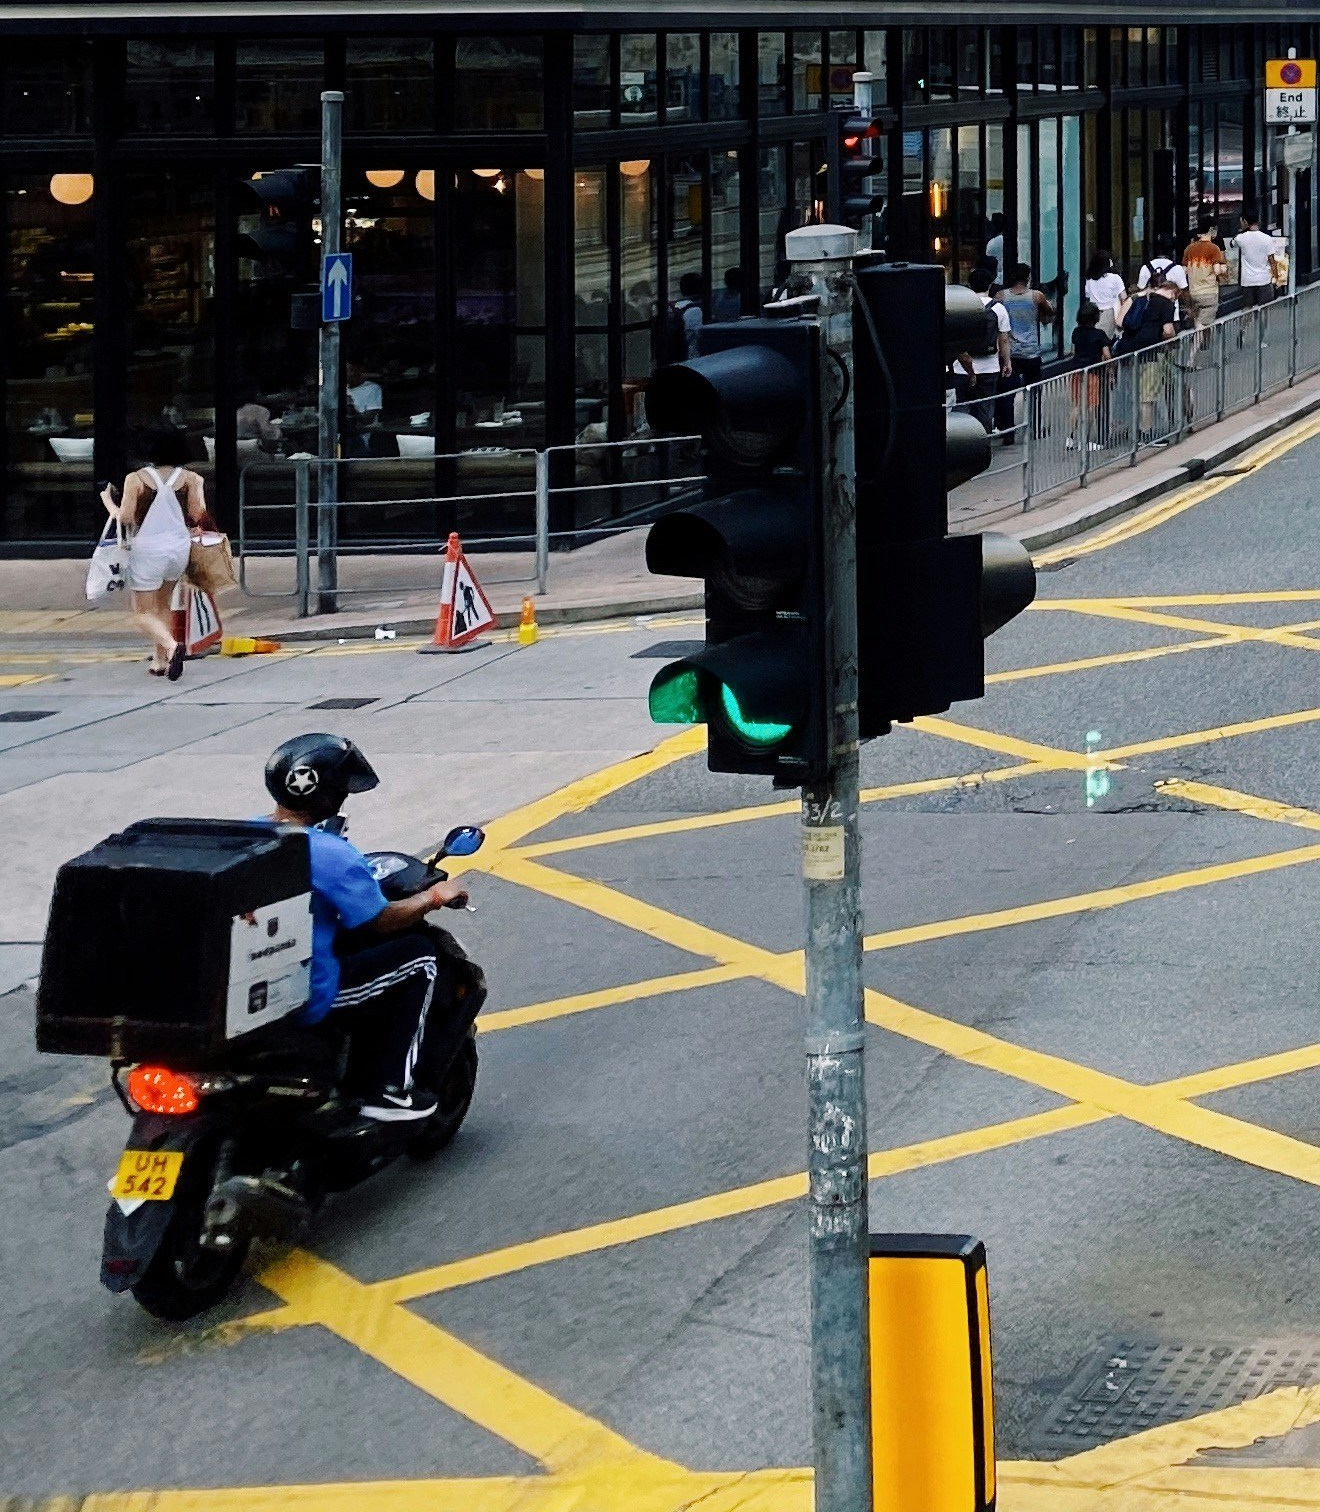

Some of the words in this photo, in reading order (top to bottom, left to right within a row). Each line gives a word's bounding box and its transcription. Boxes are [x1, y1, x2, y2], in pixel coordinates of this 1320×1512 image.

[1279, 91, 1303, 103] End
[135, 1153, 168, 1173] UH
[122, 1174, 167, 1196] 542
